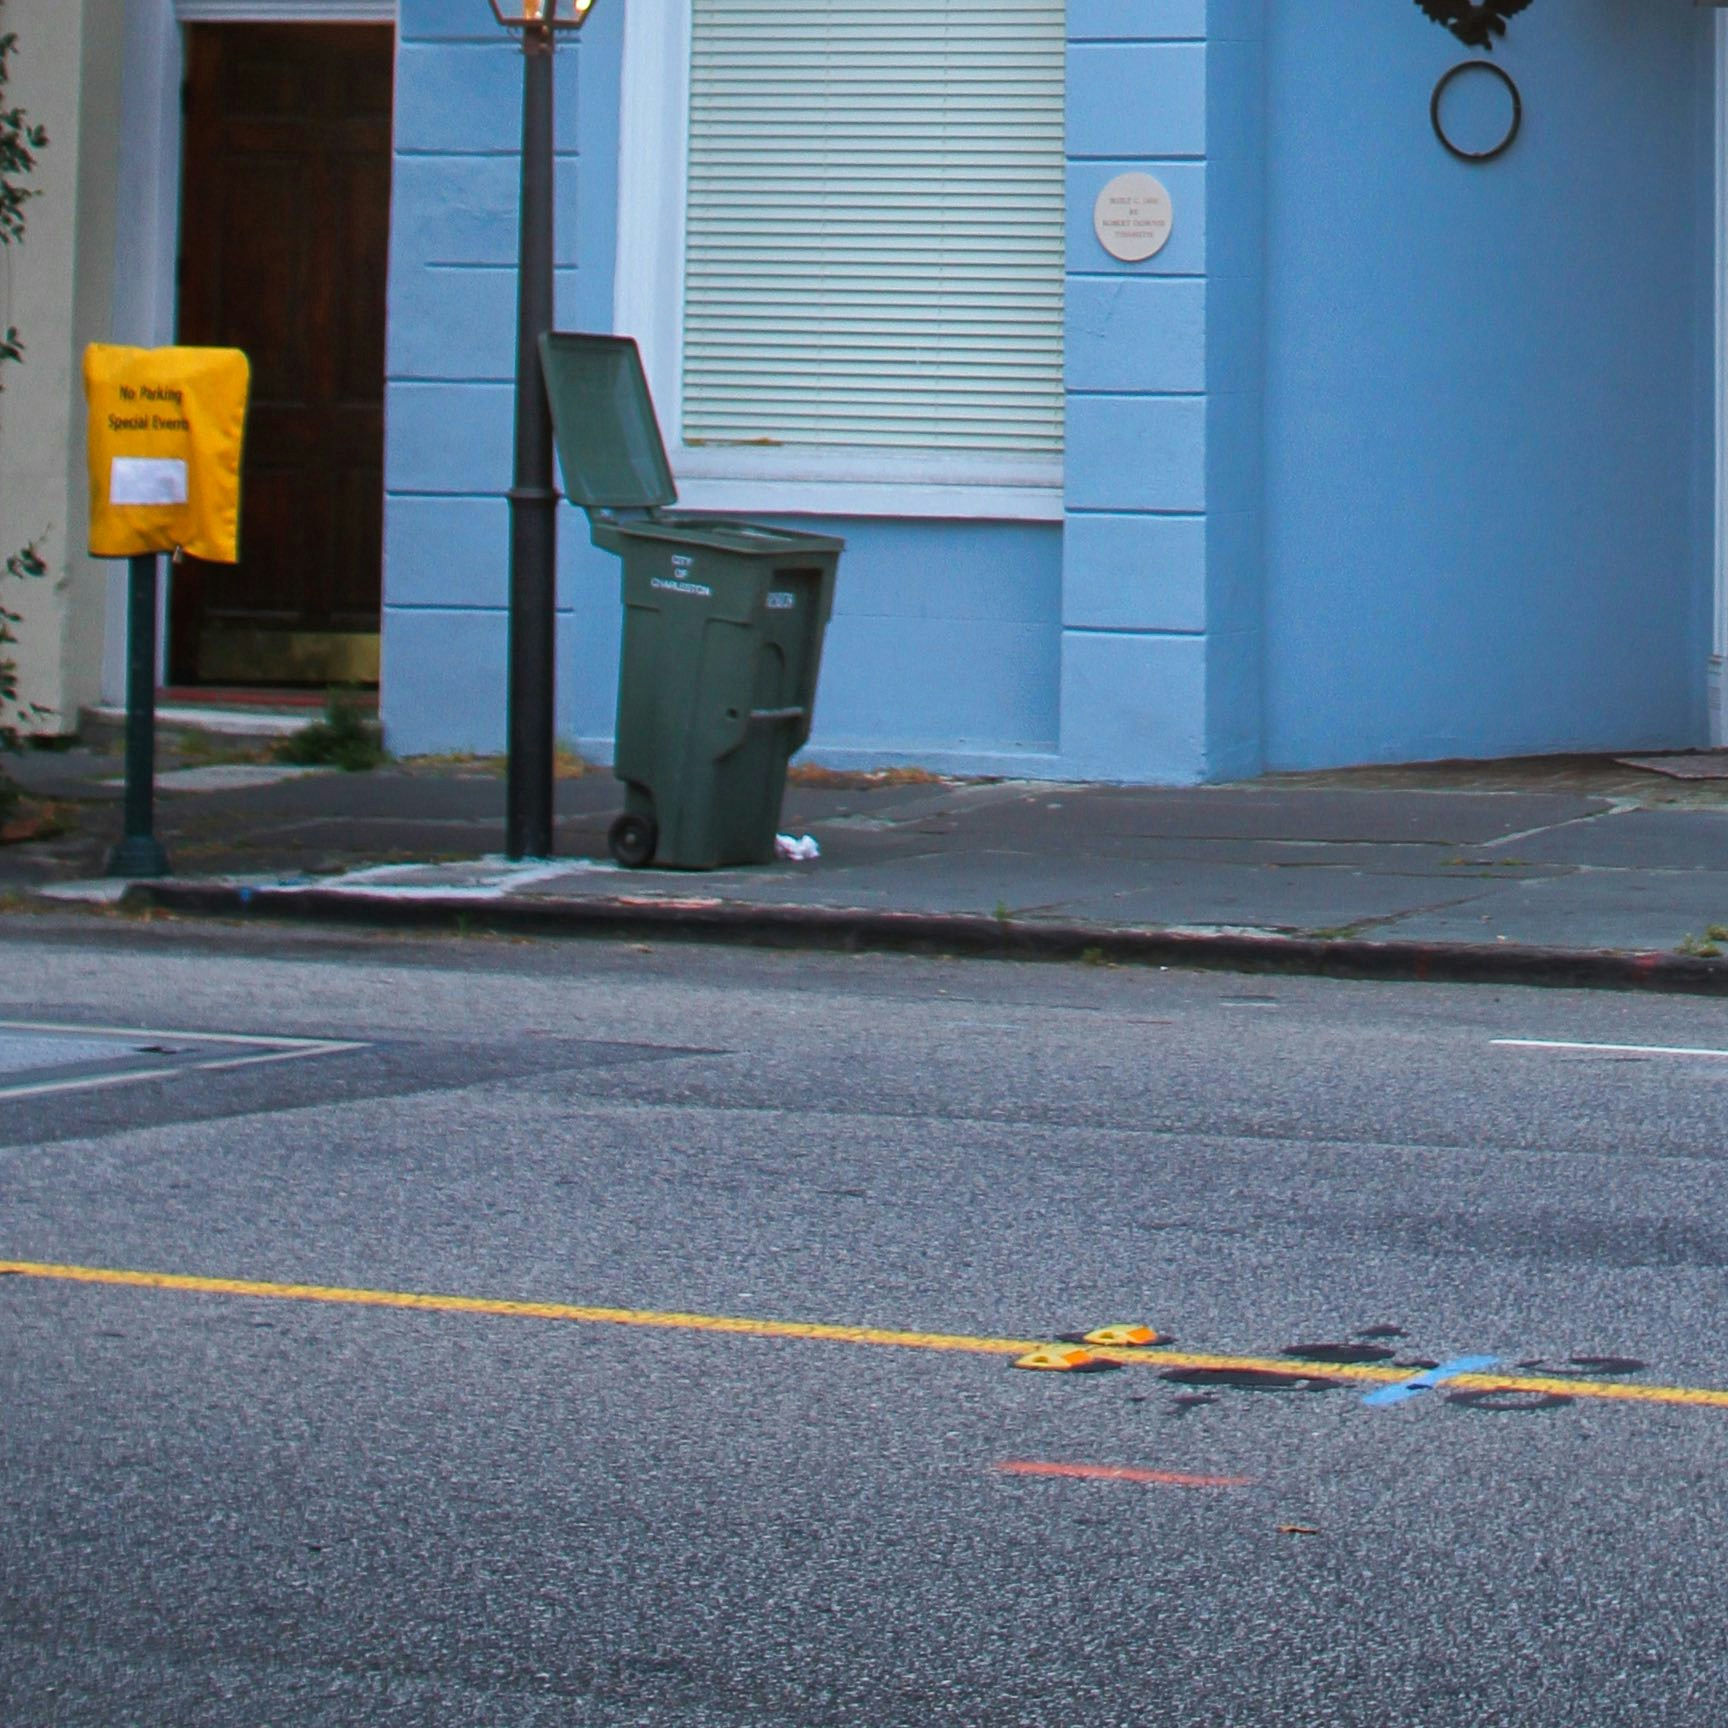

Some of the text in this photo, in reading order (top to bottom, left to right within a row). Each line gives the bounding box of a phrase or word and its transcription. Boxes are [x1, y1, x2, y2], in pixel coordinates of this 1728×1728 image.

[119, 384, 183, 406] No Parking
[108, 412, 149, 432] Special
